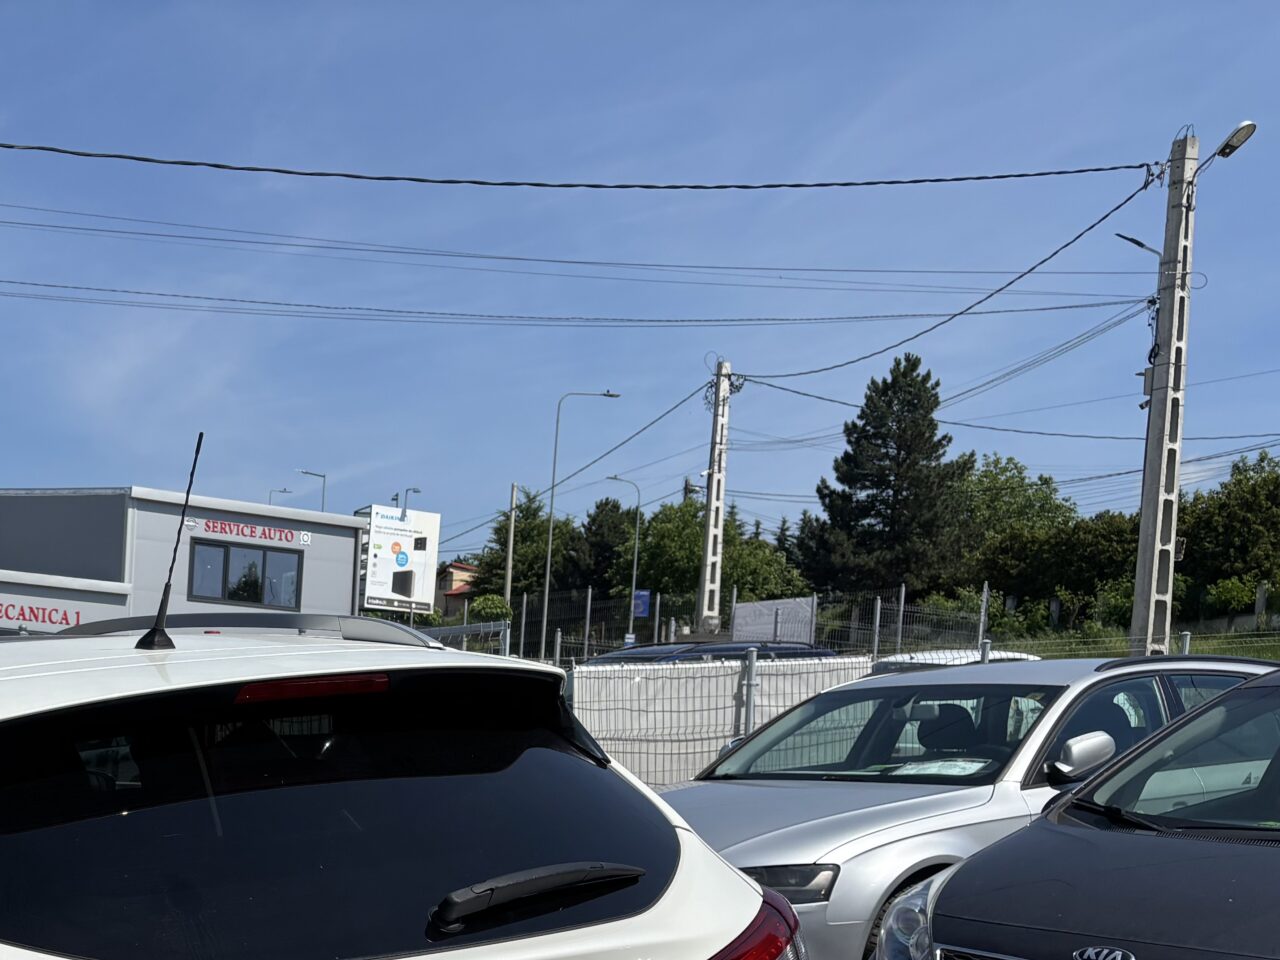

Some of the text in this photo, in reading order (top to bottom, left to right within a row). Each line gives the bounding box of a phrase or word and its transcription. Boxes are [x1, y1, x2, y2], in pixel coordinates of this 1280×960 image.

[204, 519, 295, 543] SERVICE AUTO
[74, 611, 81, 627] 1
